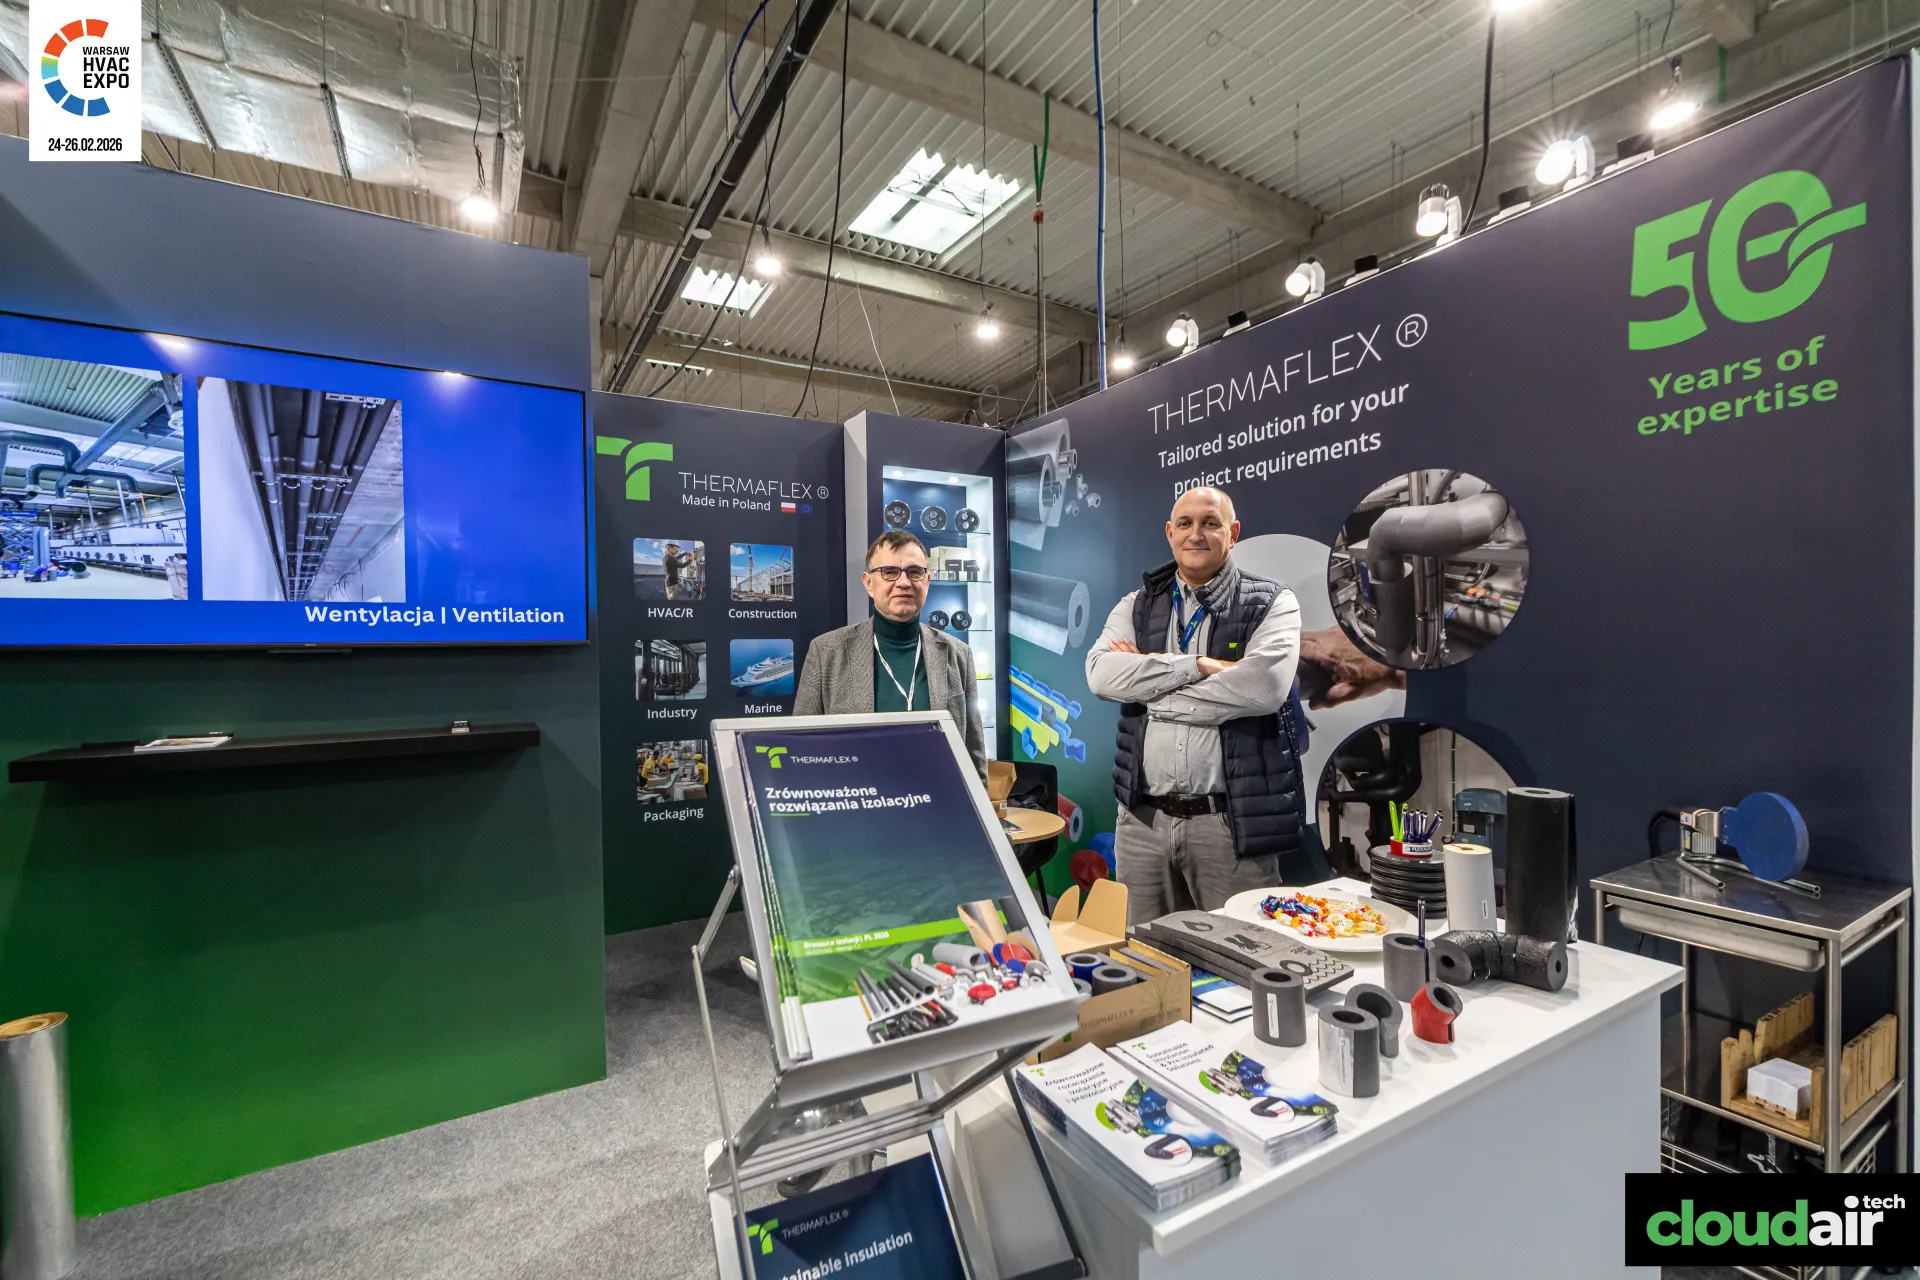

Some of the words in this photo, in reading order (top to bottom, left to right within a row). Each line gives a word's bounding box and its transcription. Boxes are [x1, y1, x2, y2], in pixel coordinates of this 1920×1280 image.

[1628, 170, 1867, 350] 50
[1648, 357, 1763, 399] Years
[1776, 334, 1826, 372] of
[1147, 324, 1382, 434] THERMAFLEX
[1637, 379, 1839, 435] expertise
[1158, 434, 1223, 468] Tailored
[1227, 414, 1306, 450] solution
[1312, 402, 1345, 427] for
[1350, 383, 1409, 422] your
[1174, 467, 1232, 500] project
[1236, 431, 1381, 482] requirements
[678, 471, 813, 500] THERMAFLEX
[682, 494, 715, 507] Made
[718, 497, 729, 509] in
[732, 498, 771, 511] Poland
[304, 606, 435, 627] Wentylacja
[452, 607, 564, 623] Ventilation
[648, 607, 694, 619] HVAC/R
[728, 608, 797, 619] Construction
[647, 707, 698, 721] Industry
[744, 703, 782, 714] Marine
[790, 756, 851, 764] THERMAFLEX
[765, 786, 878, 799] Zrównoważone
[769, 799, 859, 814] rozwiązania
[862, 792, 932, 809] izolacyjne
[643, 807, 704, 822] Packaging
[781, 1211, 842, 1240] THERMAFLEX
[845, 1231, 913, 1267] insulation
